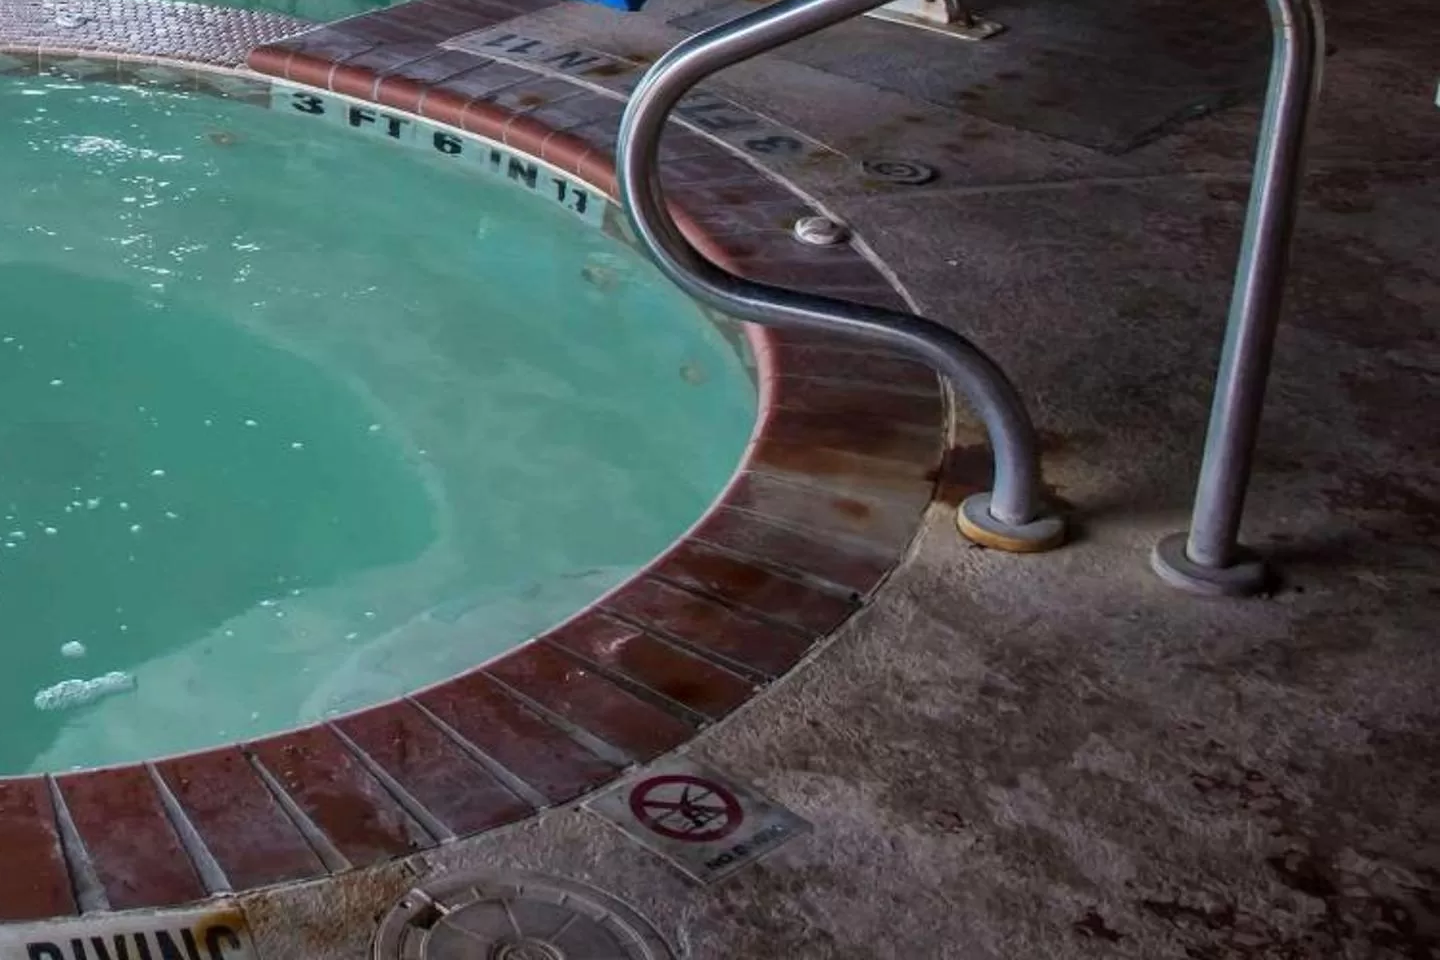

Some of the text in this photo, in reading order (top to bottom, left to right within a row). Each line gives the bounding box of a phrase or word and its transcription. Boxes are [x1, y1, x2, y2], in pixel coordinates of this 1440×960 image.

[291, 91, 326, 115] 3
[348, 105, 409, 139] FT
[432, 131, 463, 154] 6
